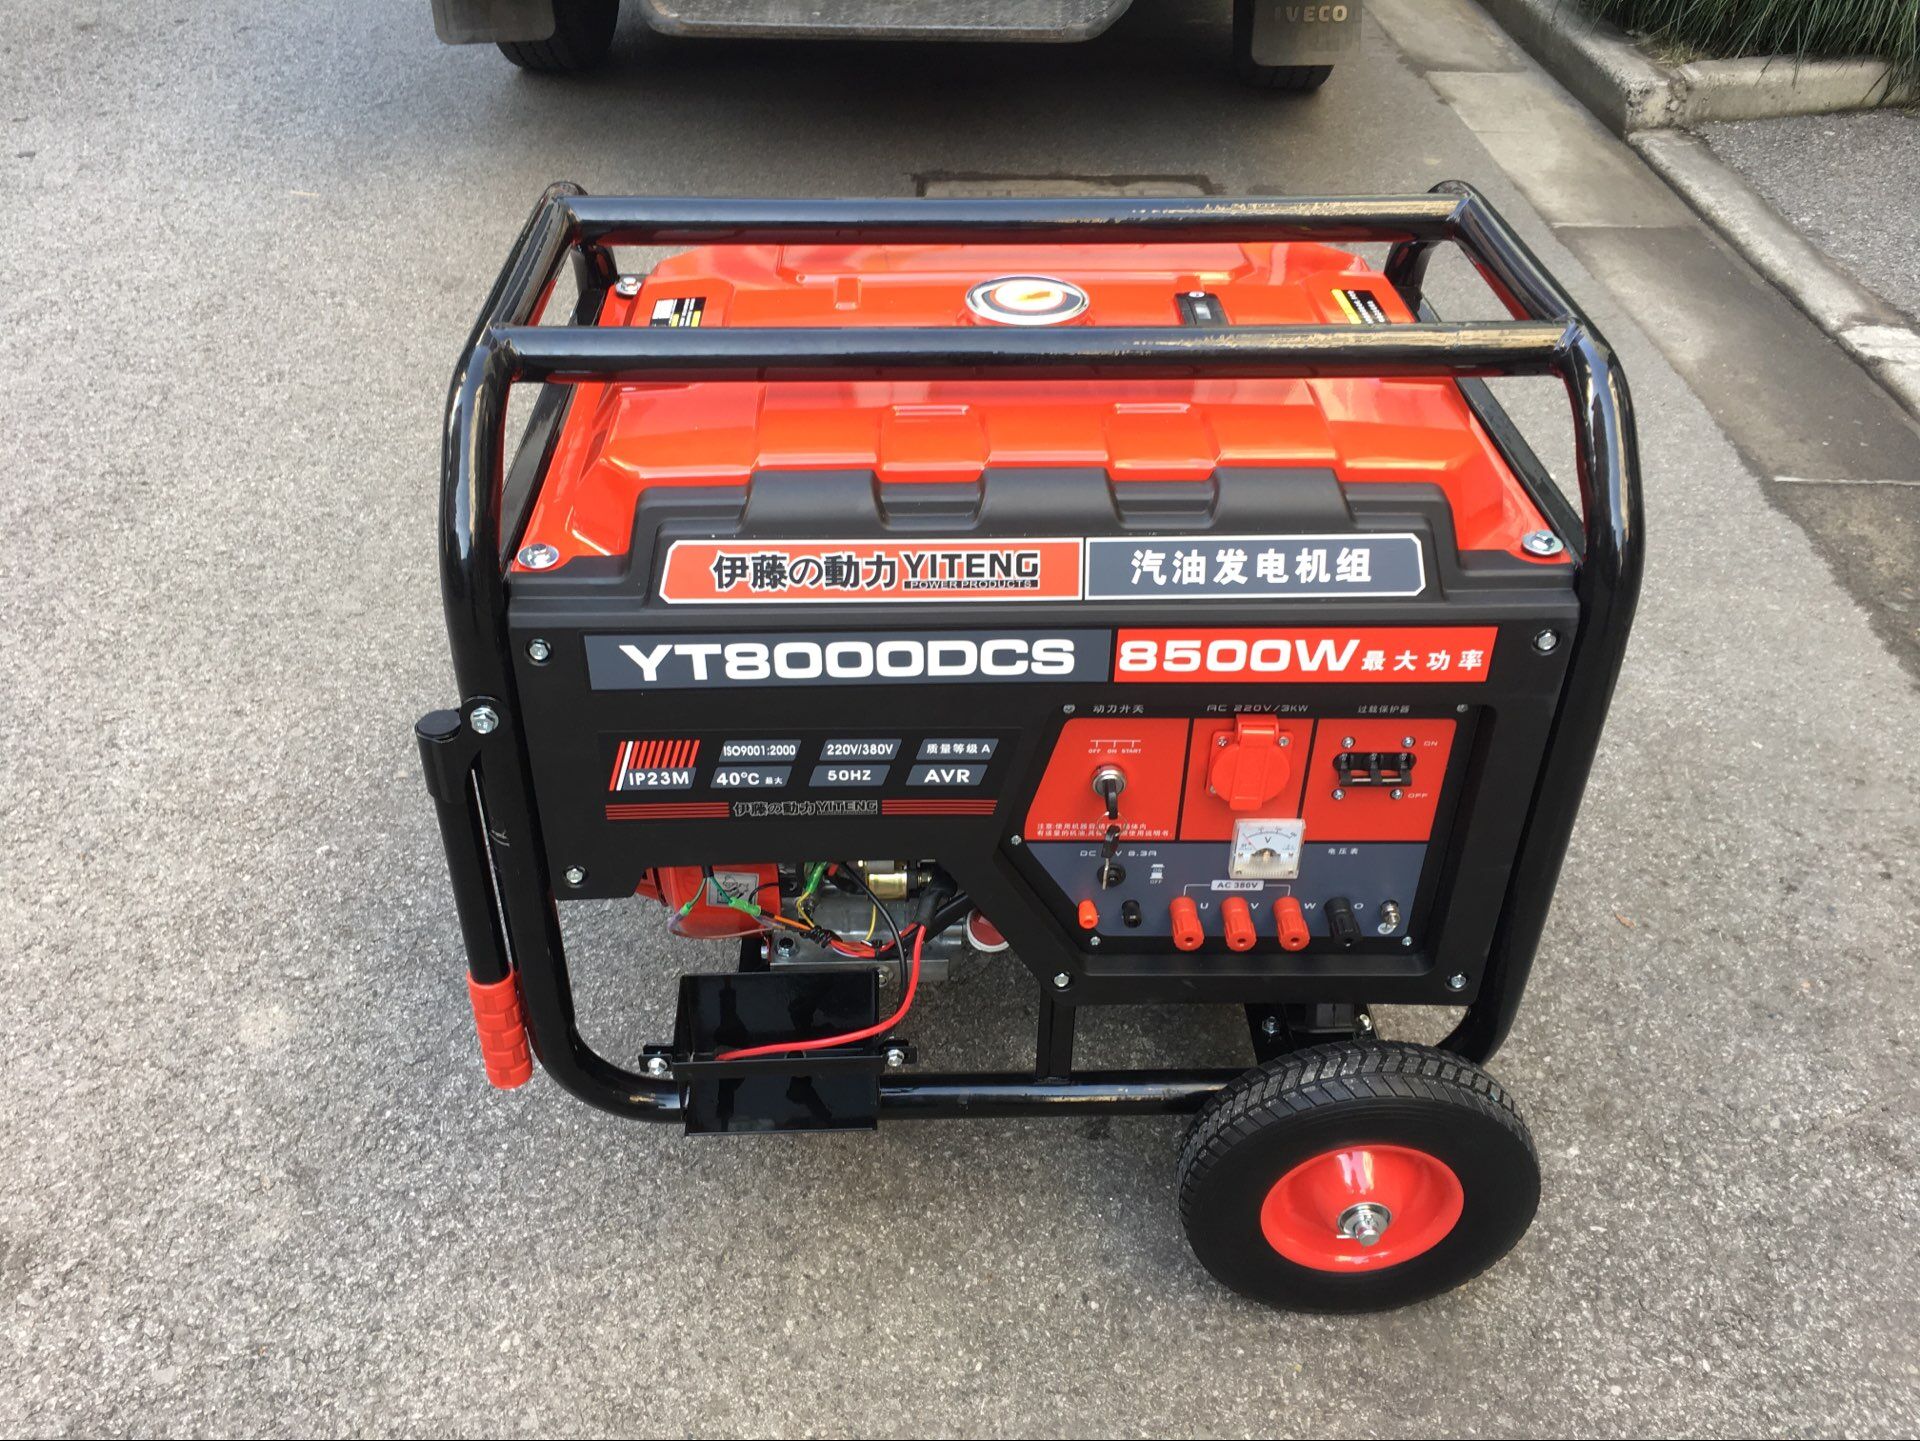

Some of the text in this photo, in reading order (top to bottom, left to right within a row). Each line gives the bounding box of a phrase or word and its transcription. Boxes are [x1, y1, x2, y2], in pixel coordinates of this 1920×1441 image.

[1273, 5, 1348, 22] IVECO
[713, 551, 1040, 590] 伊藤の動力 YITENG
[1131, 547, 1374, 586] 汽油发电机组
[910, 579, 1032, 588] POWER PRODUCTS
[619, 639, 1075, 681] YT8000DCS
[1119, 640, 1484, 672] 8500W 最大功率
[1206, 704, 1227, 712] AC
[723, 745, 796, 757] ISO9001:2000
[827, 744, 893, 755] 220V/380V
[926, 743, 991, 755] 质量等级 A
[628, 772, 690, 786] IP23M
[828, 769, 871, 781] 50HZ
[923, 768, 970, 783] AVR
[815, 800, 878, 811] YITENG
[1304, 902, 1317, 910] W
